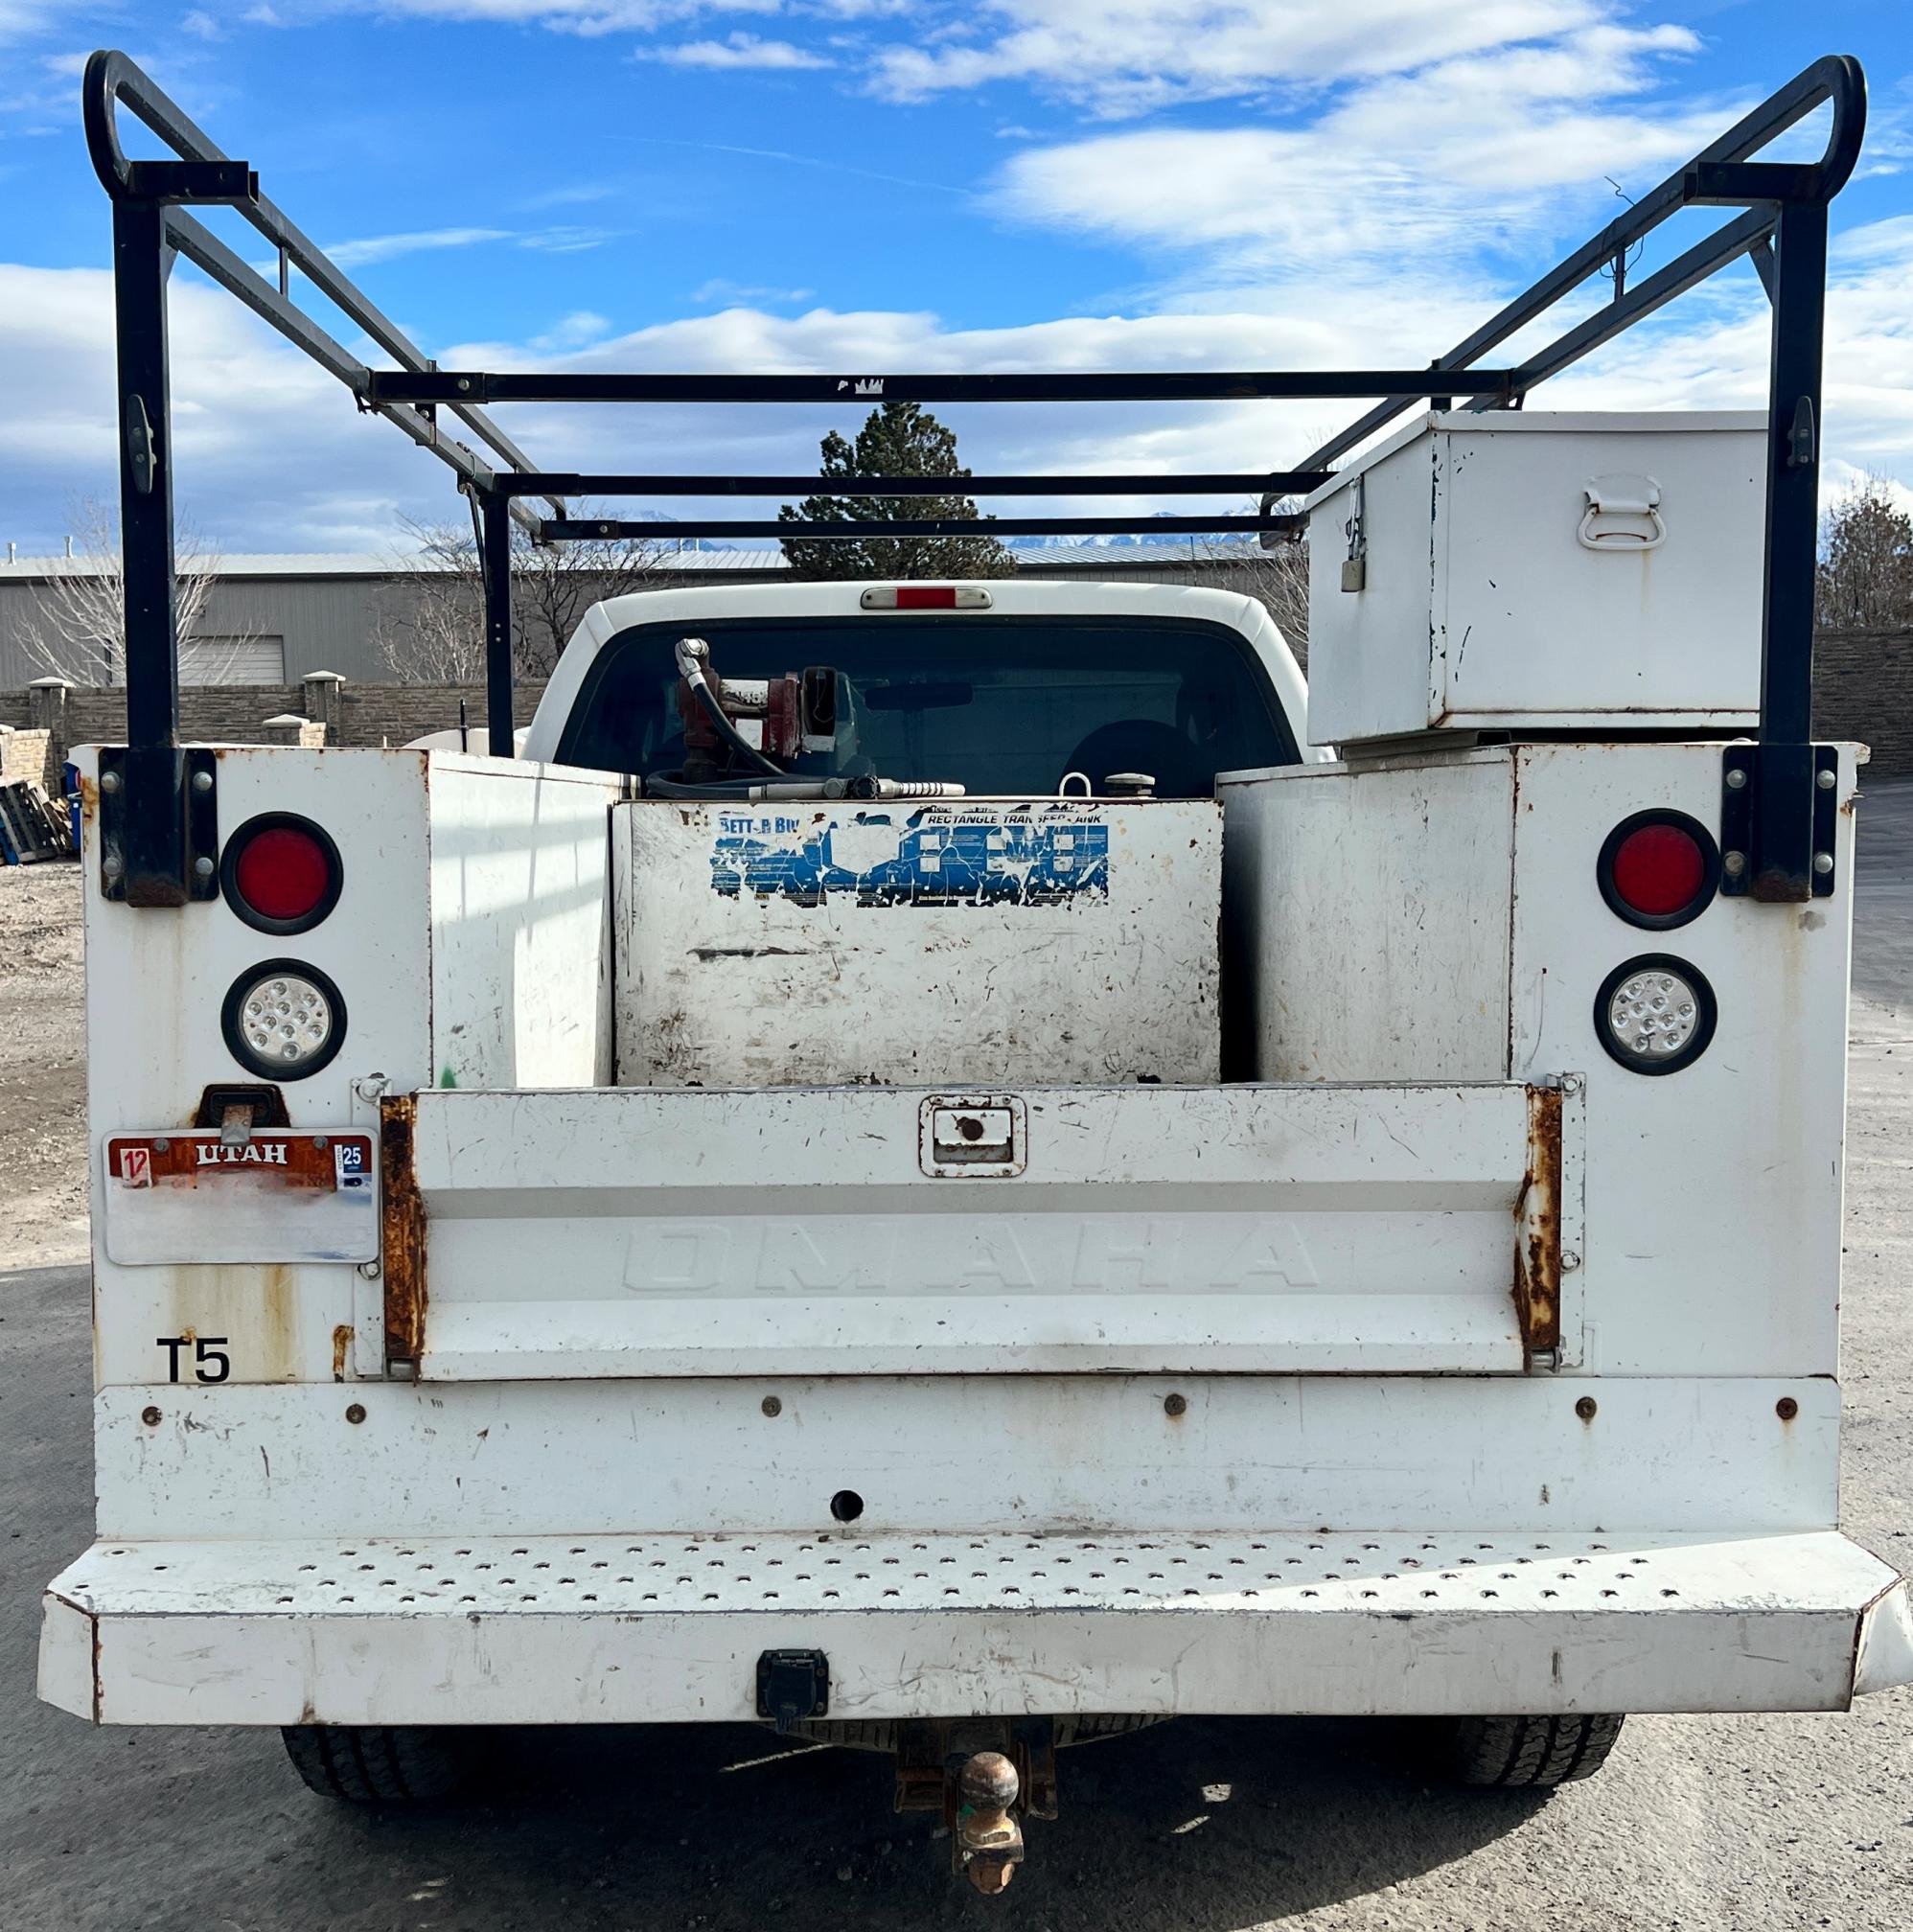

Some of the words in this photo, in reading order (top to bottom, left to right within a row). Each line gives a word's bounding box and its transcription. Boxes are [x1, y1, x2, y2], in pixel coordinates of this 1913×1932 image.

[719, 817, 771, 834] BETTR
[928, 815, 997, 824] RECTANGLE
[1074, 815, 1101, 823] ANK
[125, 1150, 148, 1180] 12
[196, 1143, 288, 1165] UTAH
[343, 1146, 361, 1165] 25
[621, 1220, 1321, 1292] OMAHA
[156, 1337, 230, 1383] T5
